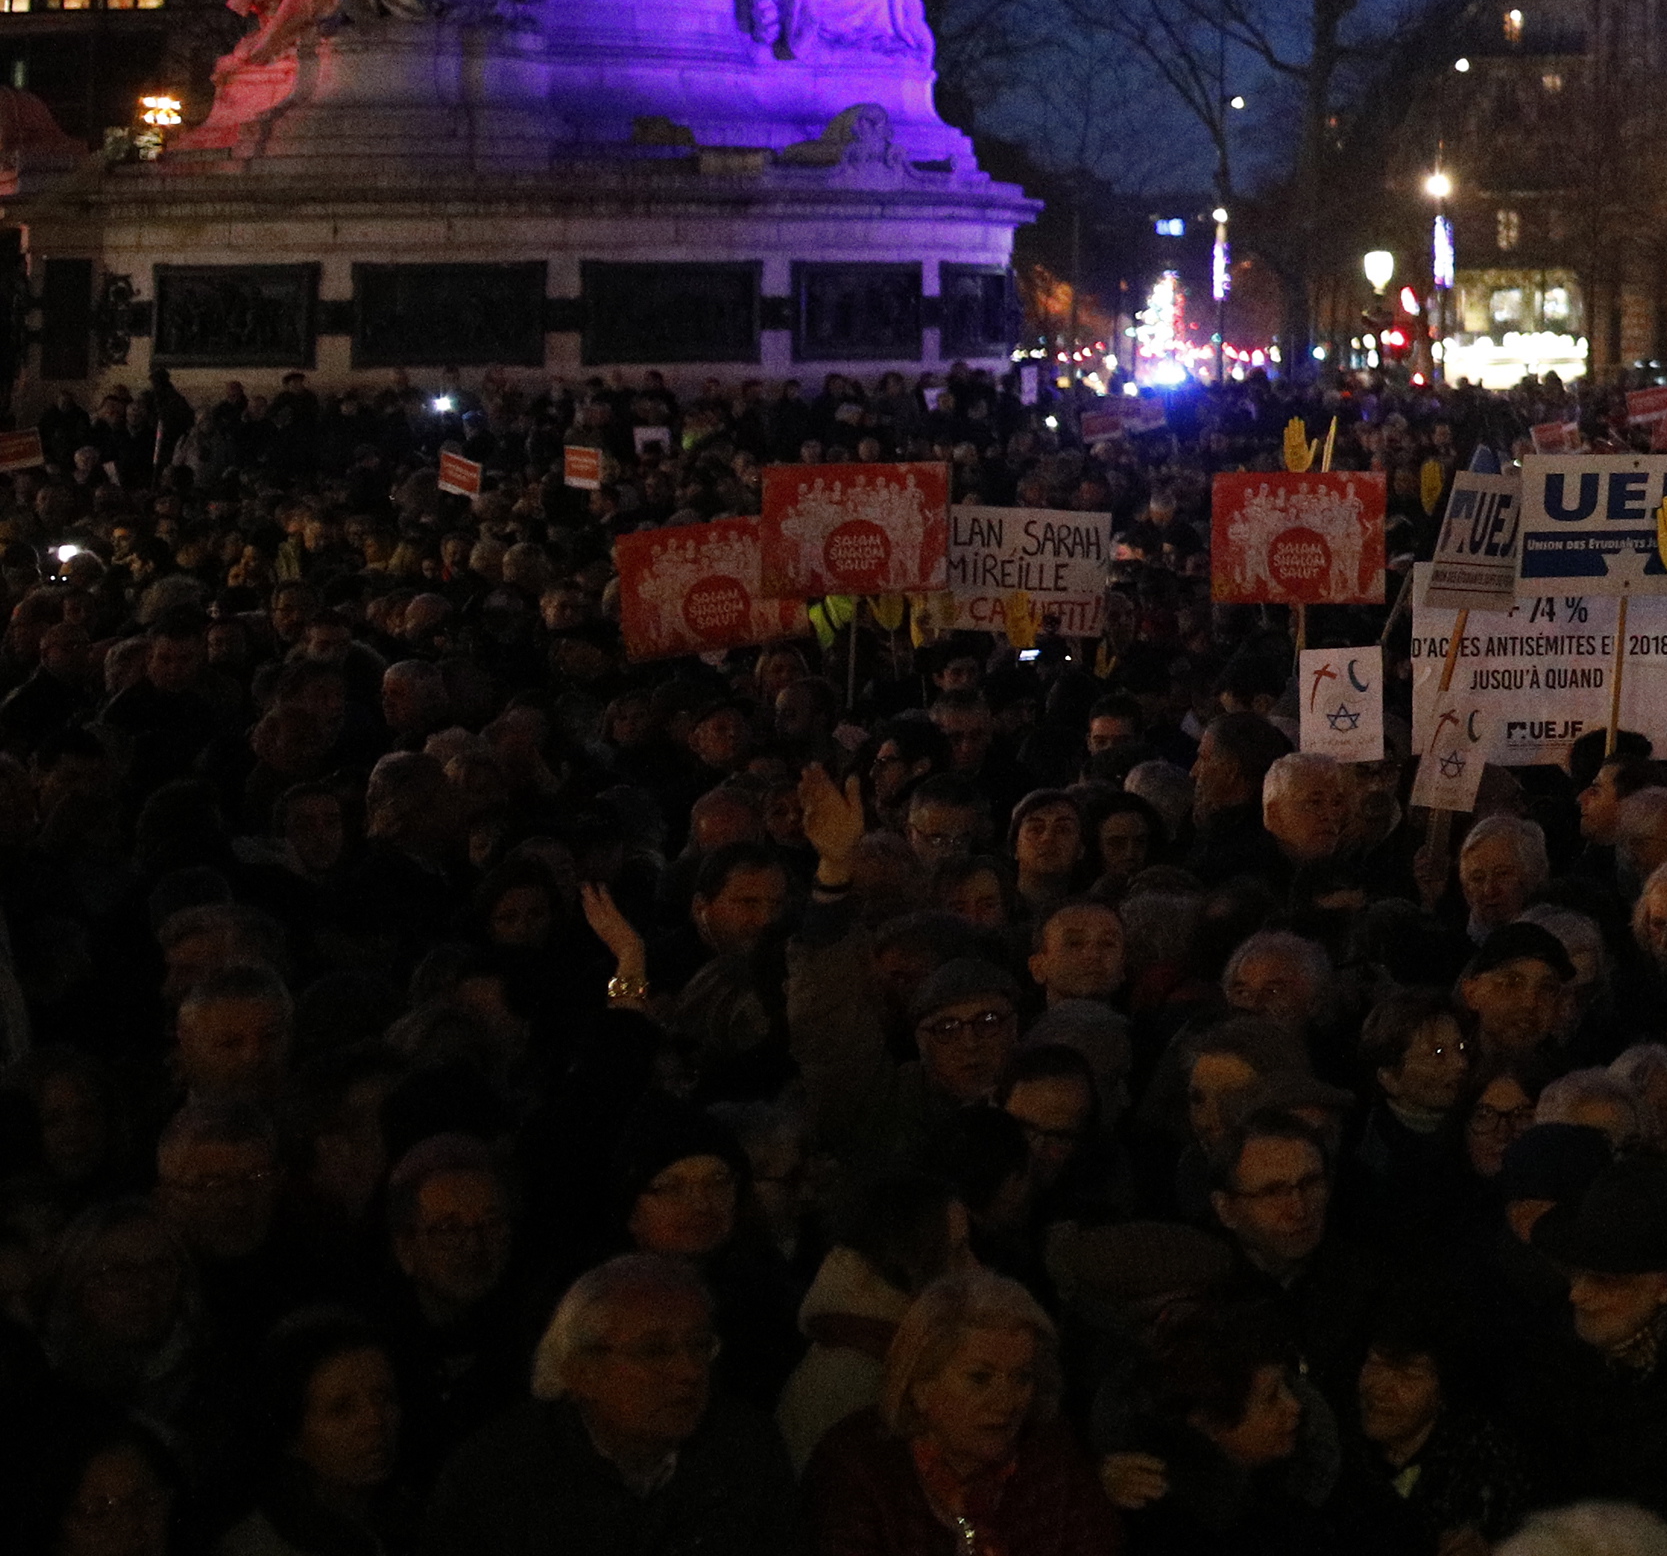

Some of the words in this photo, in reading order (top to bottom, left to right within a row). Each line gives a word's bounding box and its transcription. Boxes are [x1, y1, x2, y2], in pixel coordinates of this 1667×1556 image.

[1412, 637, 1480, 657] D'ACES
[1486, 632, 1595, 657] ANTISÉMITES
[1470, 665, 1540, 690] JUSQU'À
[1546, 669, 1603, 688] QUAND
[1531, 721, 1583, 739] UEJF
